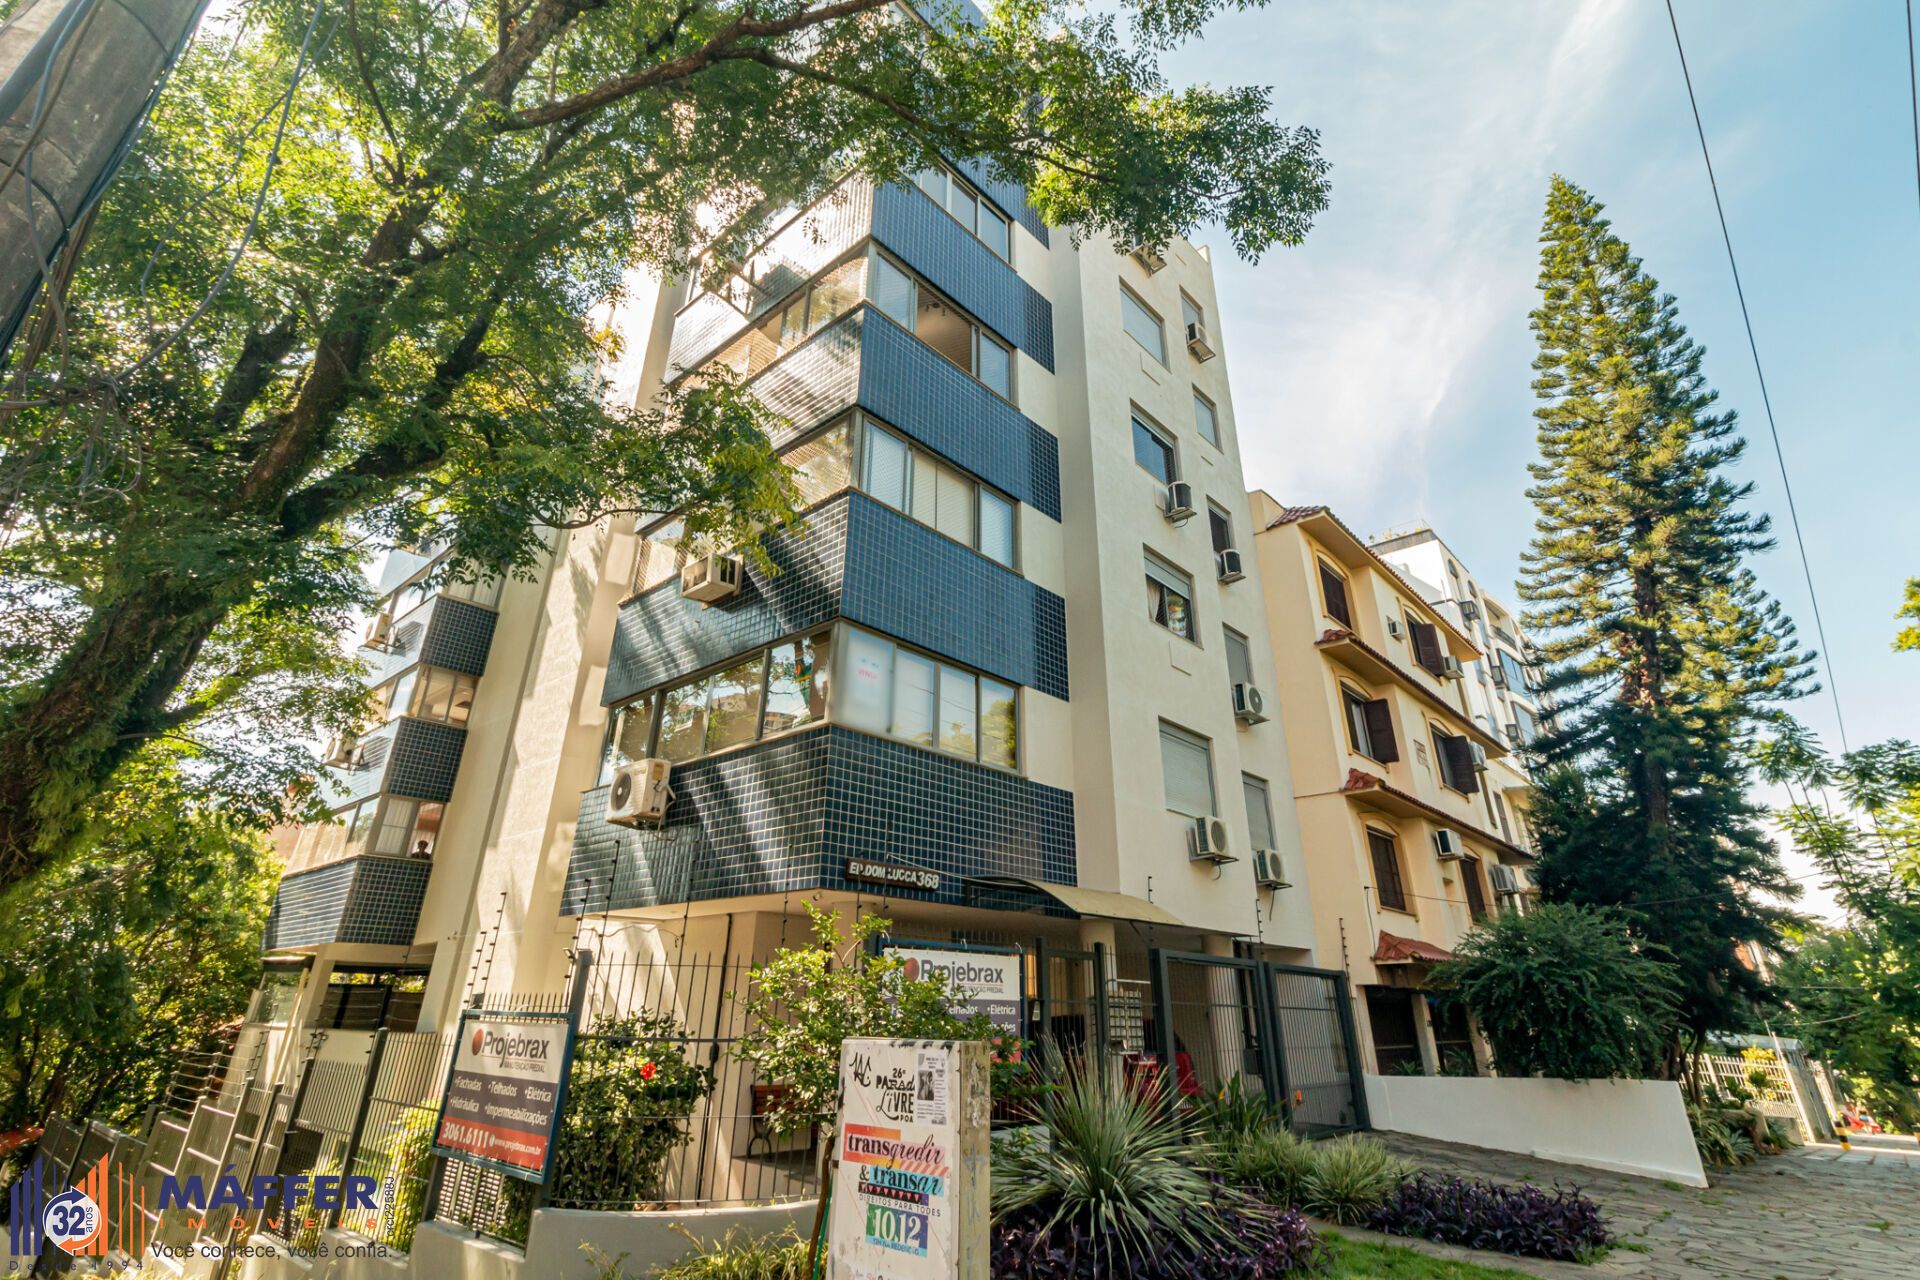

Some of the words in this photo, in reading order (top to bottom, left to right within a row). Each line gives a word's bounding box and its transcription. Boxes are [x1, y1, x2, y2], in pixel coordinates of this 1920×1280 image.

[917, 871, 940, 889] 368
[481, 1031, 550, 1068] Projebrax
[490, 1081, 518, 1096] Telhados
[526, 1086, 552, 1102] Elétrica
[486, 1103, 548, 1126] Impermeabilizações
[442, 1121, 490, 1149] 3061.6111
[848, 1133, 944, 1170] transgredir
[859, 1164, 870, 1181] &
[873, 1167, 944, 1196] transar
[894, 1199, 913, 1211] PARA
